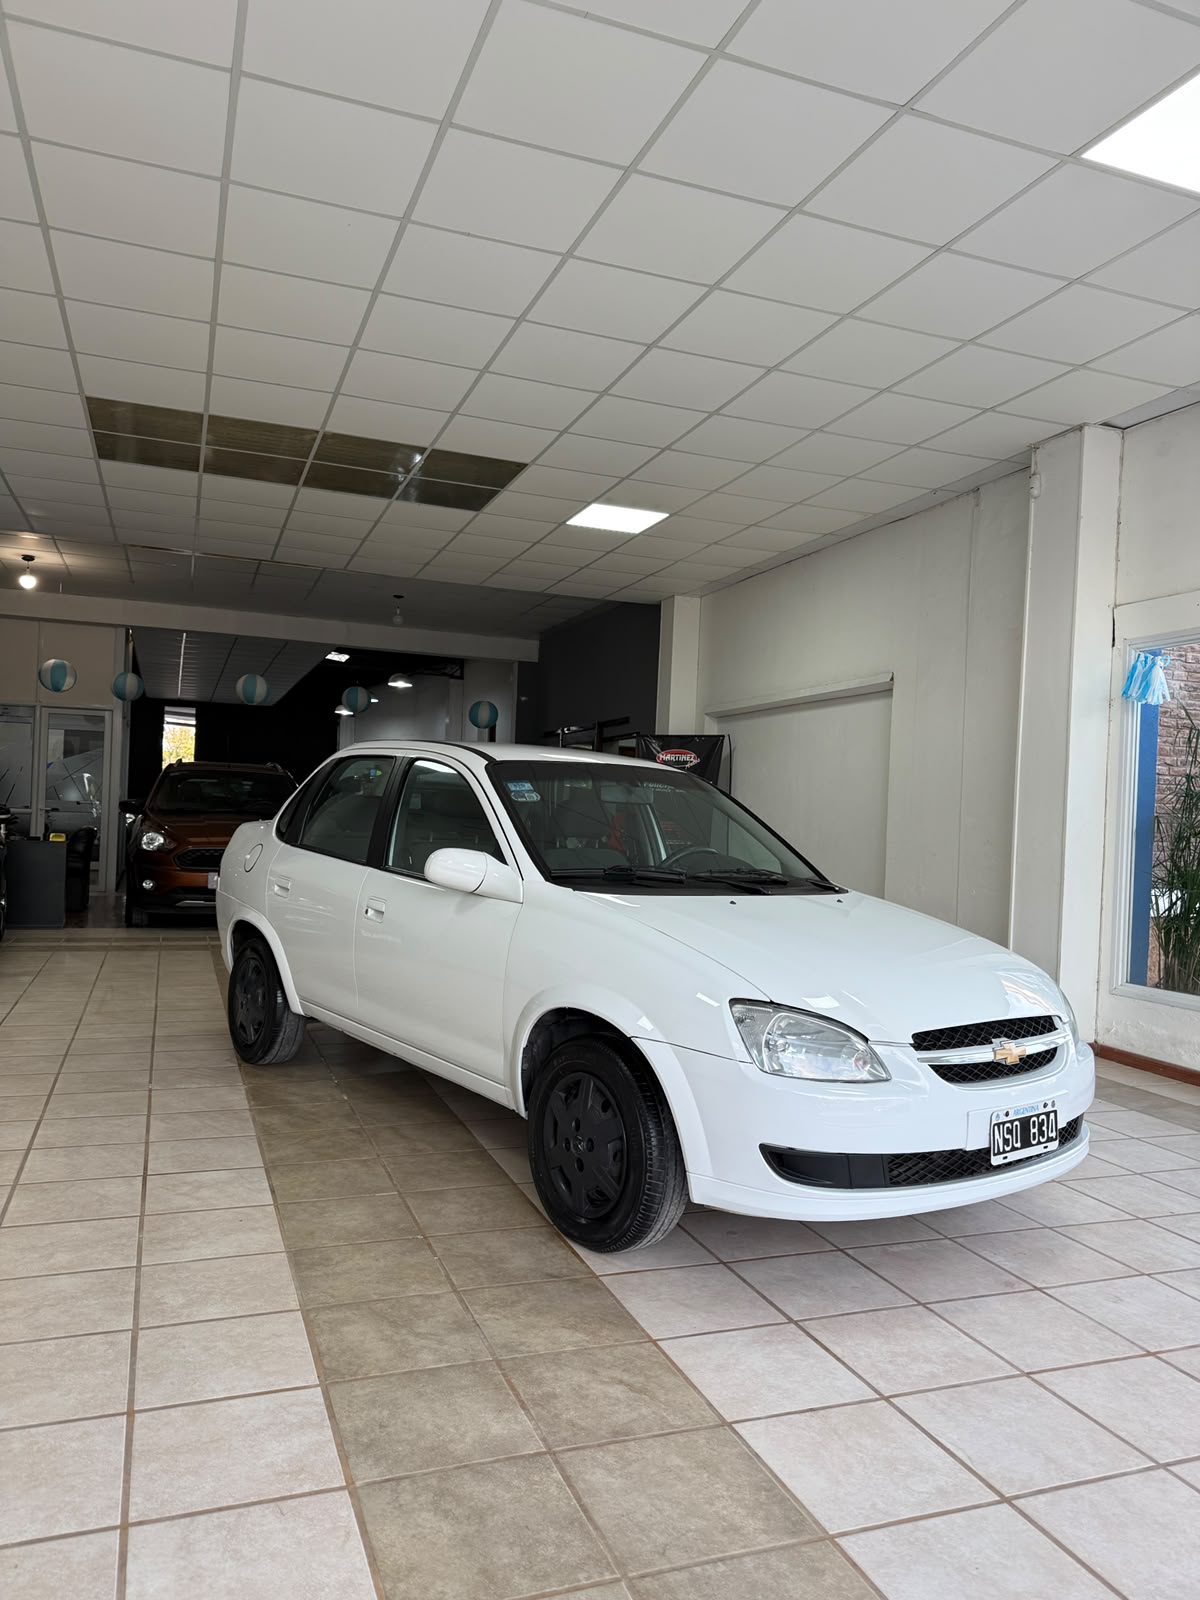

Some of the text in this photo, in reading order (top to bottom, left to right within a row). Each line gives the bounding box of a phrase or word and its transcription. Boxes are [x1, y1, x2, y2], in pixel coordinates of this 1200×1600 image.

[660, 754, 695, 762] MARTINEZ
[1013, 1104, 1040, 1116] ARGENTINA
[994, 1112, 1057, 1154] NSQ 834
